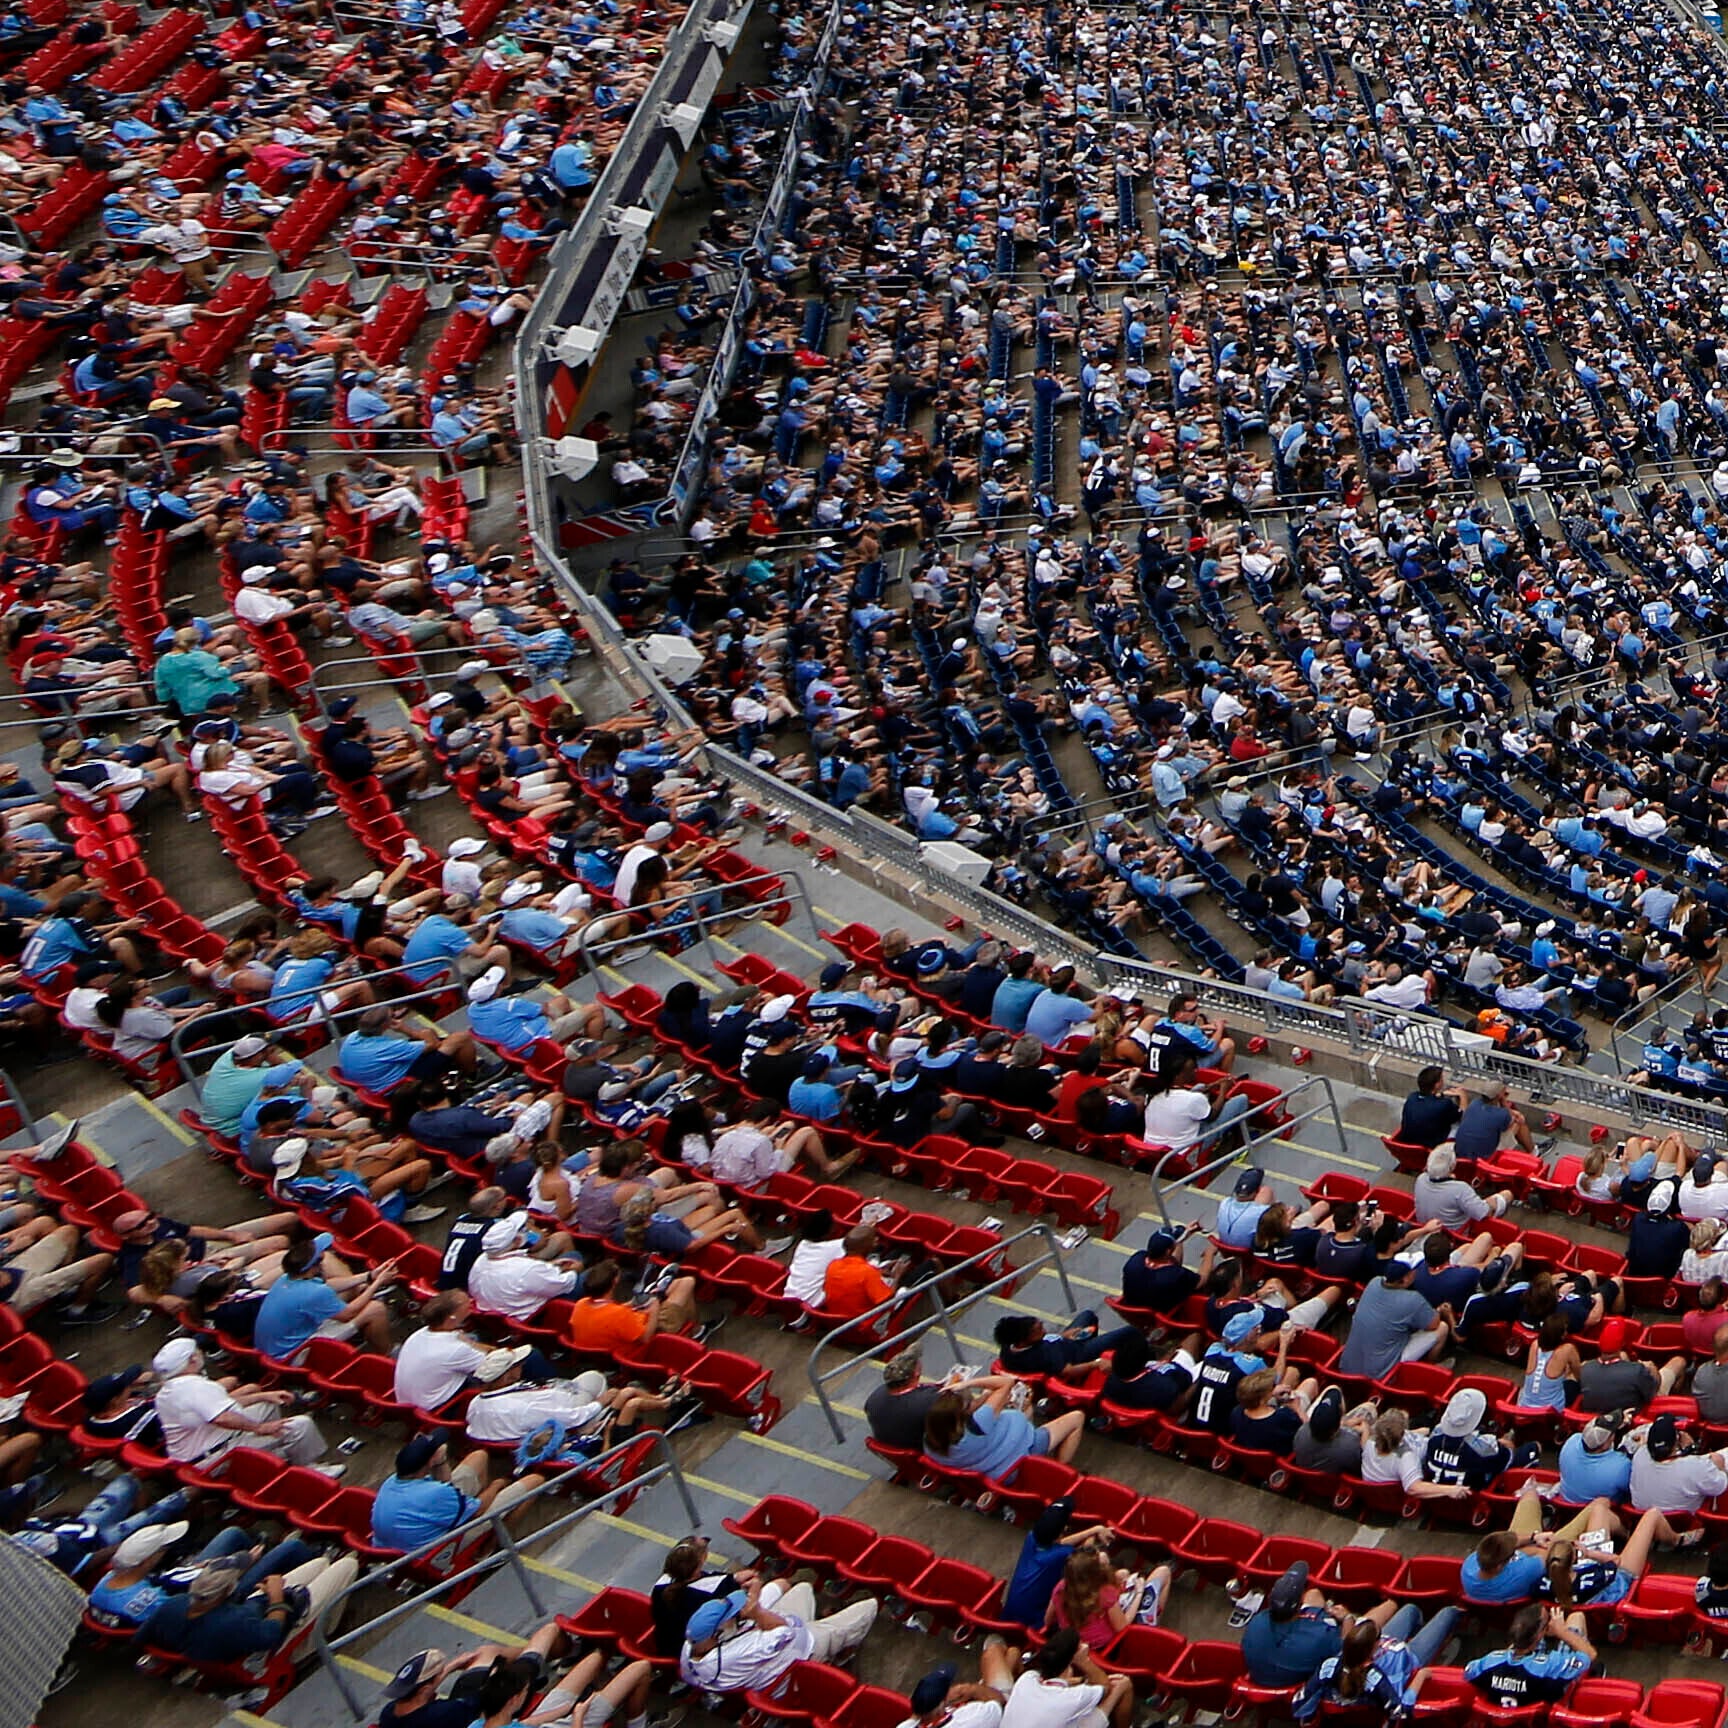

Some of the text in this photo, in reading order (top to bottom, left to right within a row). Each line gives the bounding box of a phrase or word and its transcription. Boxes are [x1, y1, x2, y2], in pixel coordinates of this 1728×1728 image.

[1202, 1366, 1231, 1384] MARIOTA
[1197, 1388, 1214, 1422] 8
[1433, 1449, 1460, 1466] LEWAN
[1491, 1674, 1527, 1694] MARIOTA
